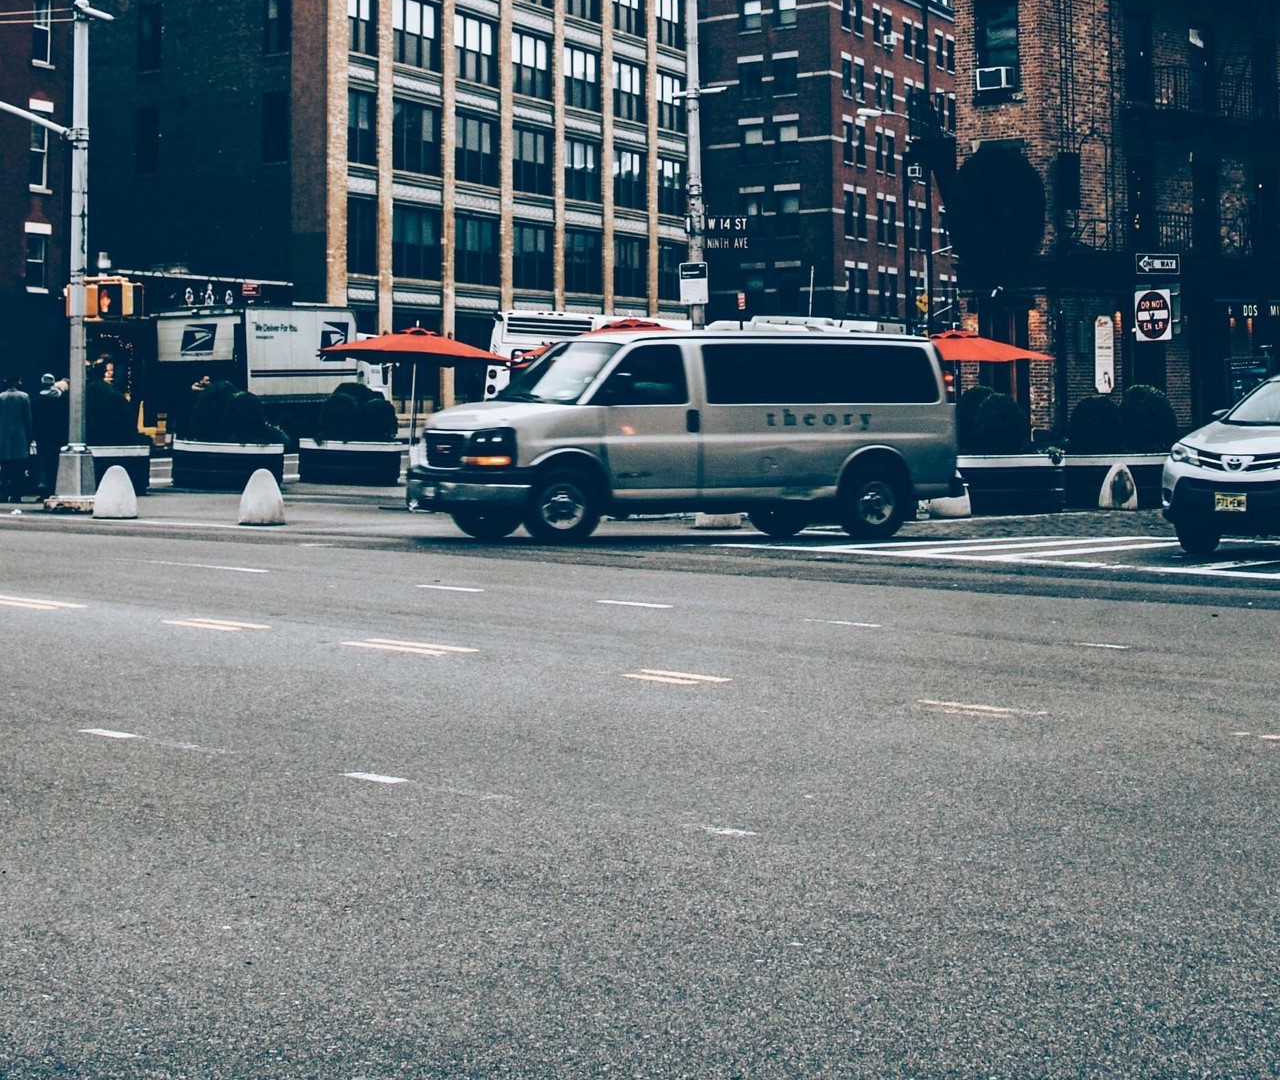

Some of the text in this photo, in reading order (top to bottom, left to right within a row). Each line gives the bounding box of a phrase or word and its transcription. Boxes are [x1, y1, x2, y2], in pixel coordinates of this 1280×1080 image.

[707, 218, 748, 230] W 14 ST
[707, 237, 749, 249] NINTH AVE
[1143, 260, 1174, 268] ONE WAY
[1141, 300, 1163, 309] DO NOT
[1243, 304, 1258, 316] DOS
[255, 323, 263, 332] We
[263, 323, 280, 332] Deliver
[280, 323, 288, 332] For
[1143, 321, 1163, 331] ENER
[766, 408, 872, 431] theory
